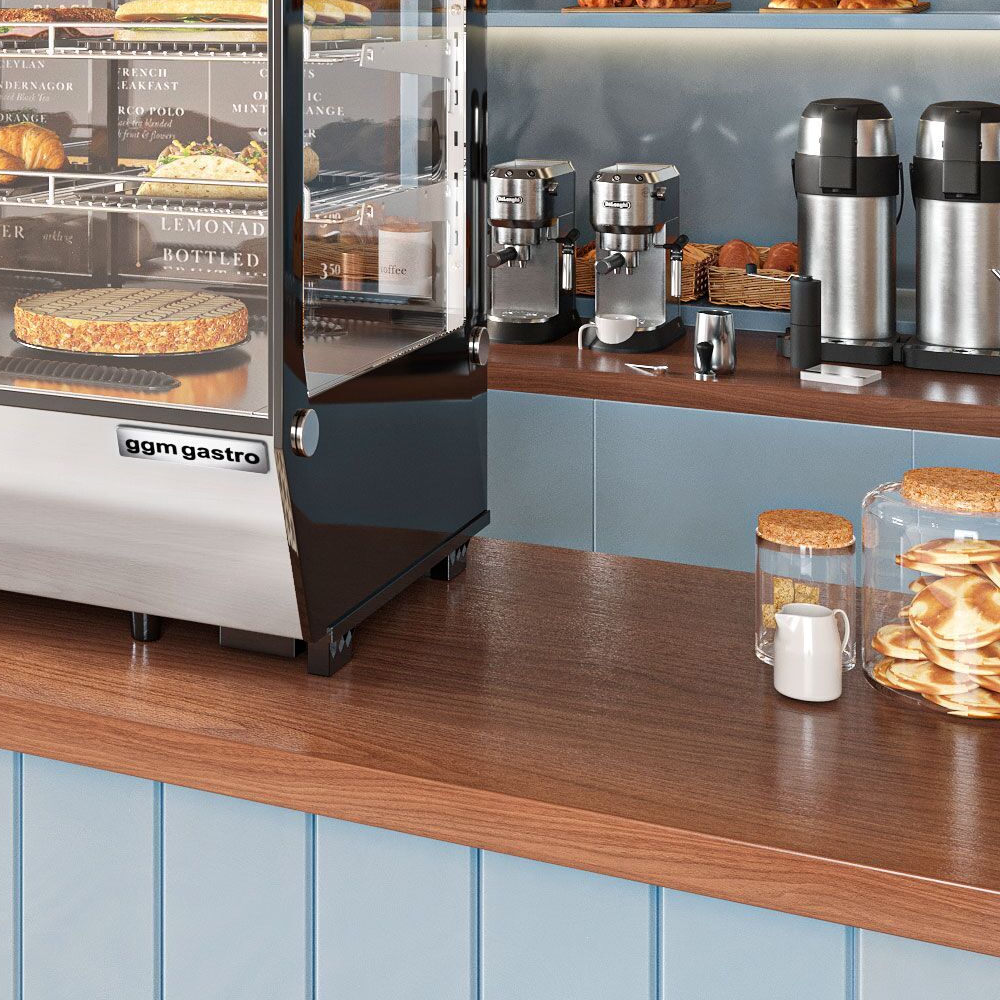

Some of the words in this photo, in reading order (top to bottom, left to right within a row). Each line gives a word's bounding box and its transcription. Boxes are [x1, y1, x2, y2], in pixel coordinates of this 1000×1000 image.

[117, 67, 168, 78] RENCH
[117, 81, 179, 91] EAKFAST
[118, 106, 145, 116] RCO
[149, 107, 185, 117] POLO
[232, 103, 268, 114] MINT
[305, 106, 345, 116] ANGE
[161, 216, 266, 237] LEMONAD
[162, 247, 260, 268] BOTTLED
[125, 438, 178, 456] ggm
[181, 444, 261, 465] gastro
